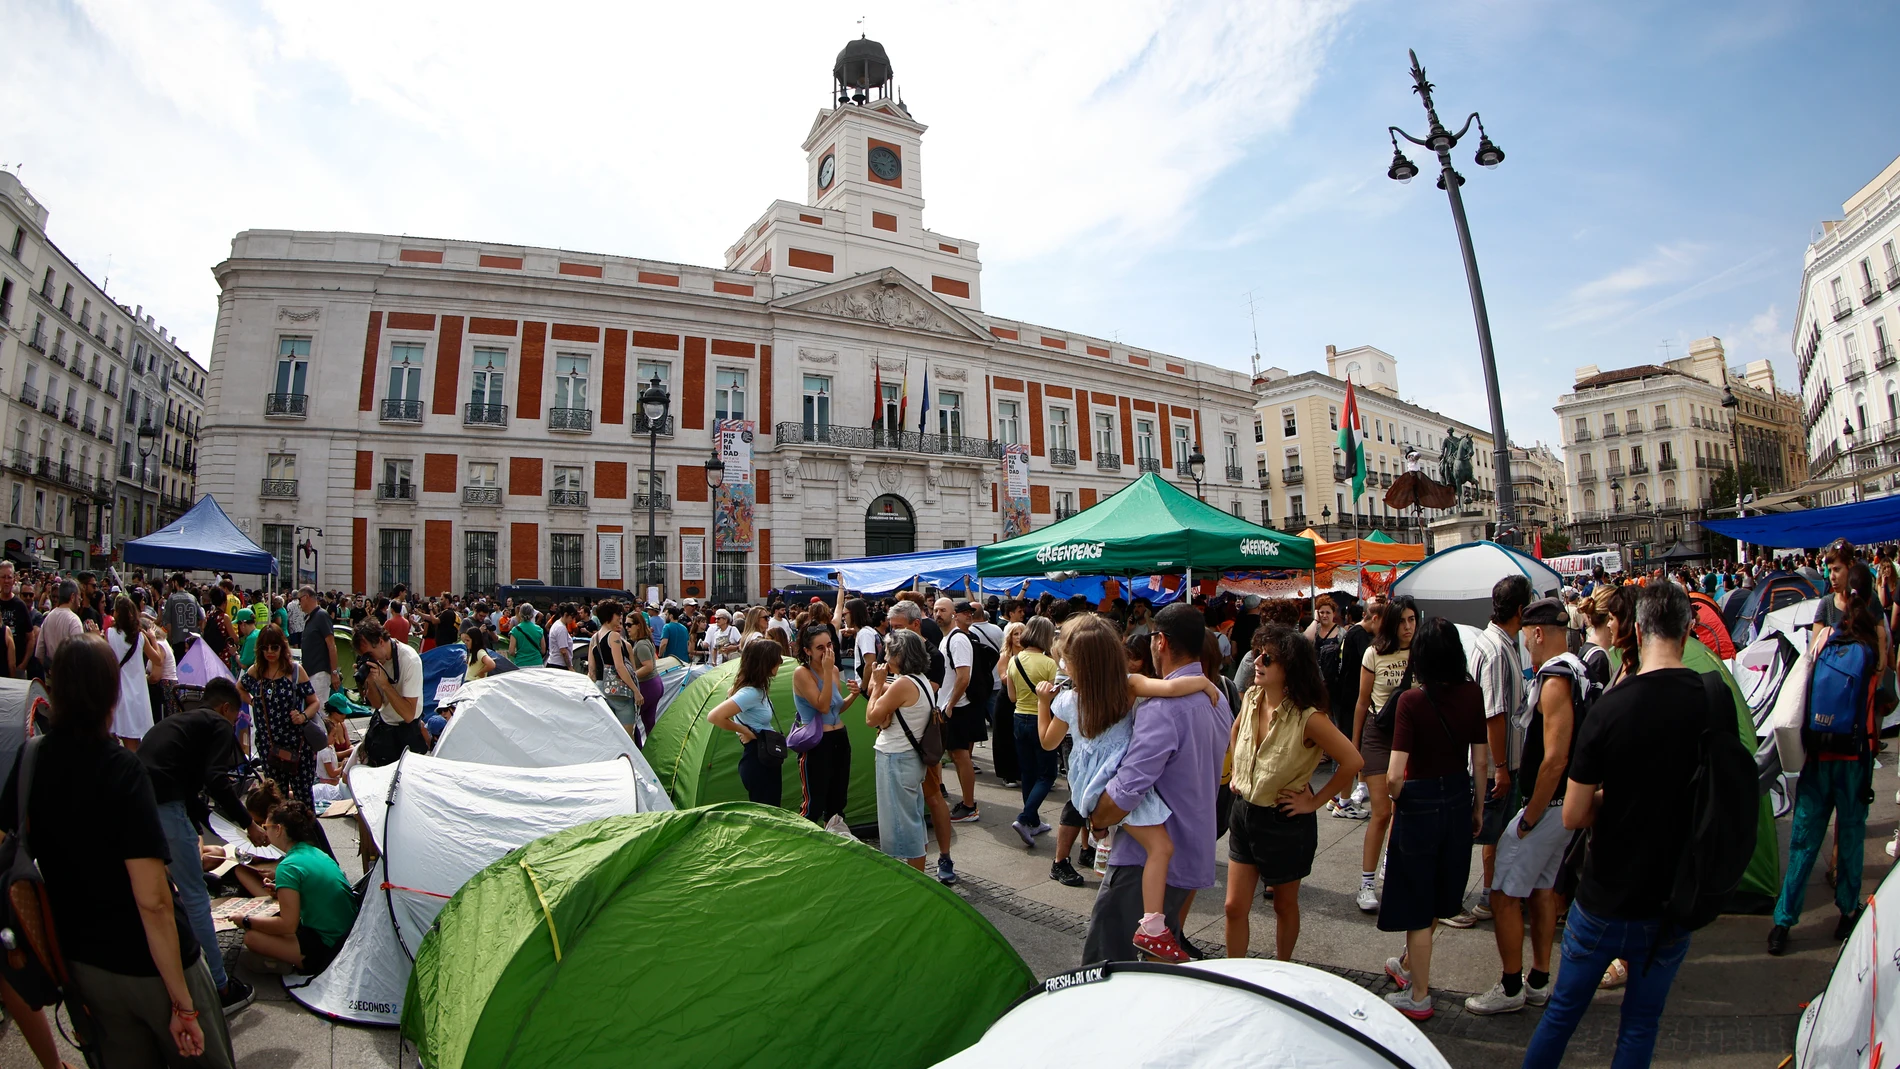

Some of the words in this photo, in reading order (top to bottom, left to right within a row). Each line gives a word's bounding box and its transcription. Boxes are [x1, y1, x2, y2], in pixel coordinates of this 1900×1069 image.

[1036, 542, 1105, 565] GREENPEACE
[175, 602, 197, 628] 83
[392, 1004, 398, 1014] 2
